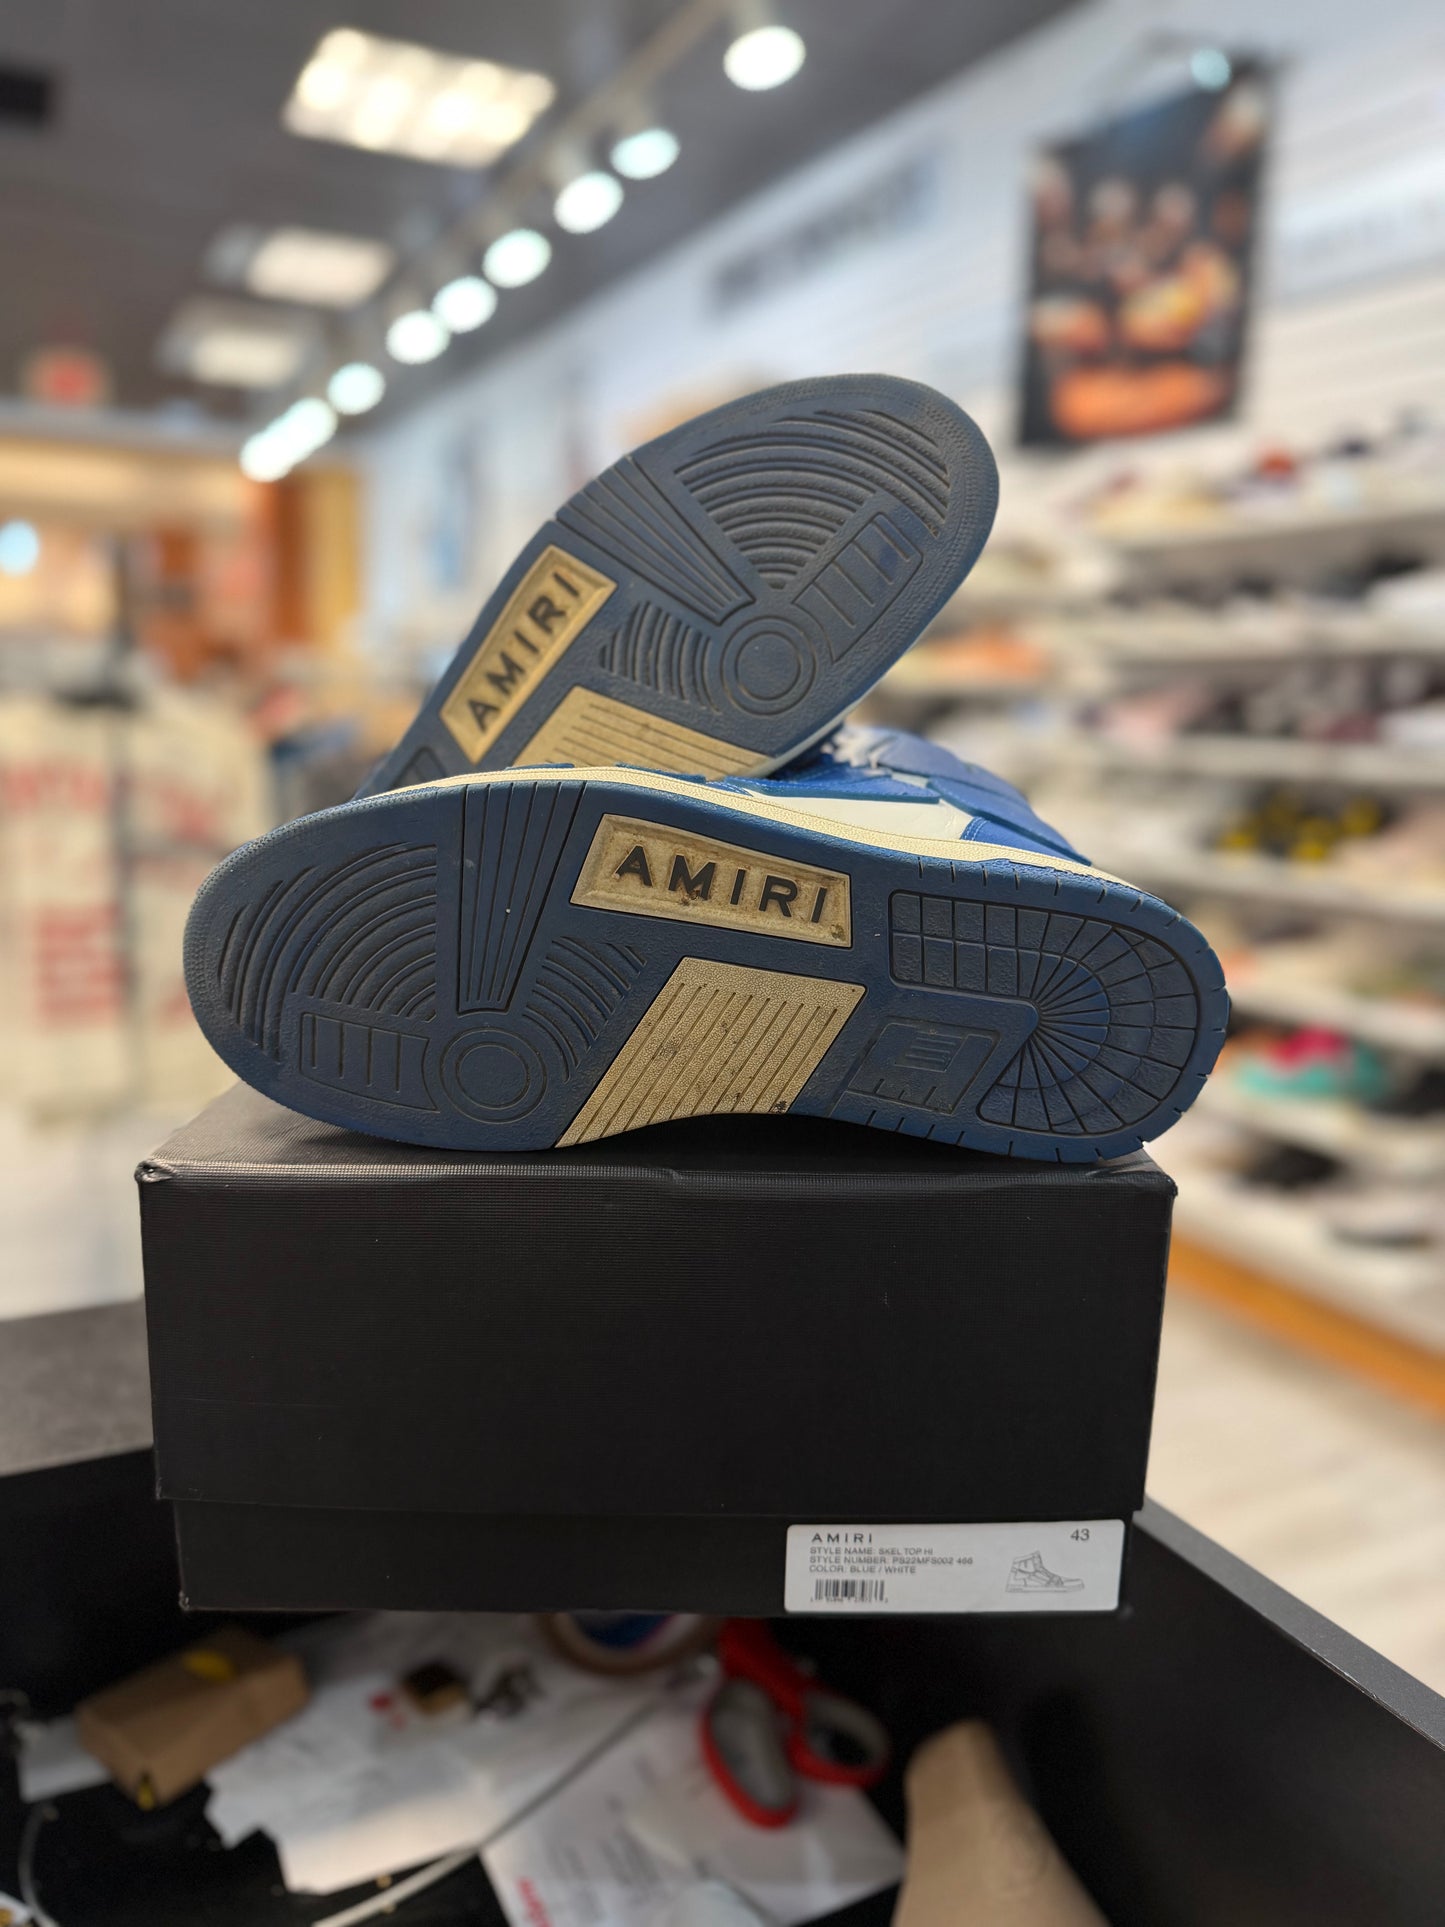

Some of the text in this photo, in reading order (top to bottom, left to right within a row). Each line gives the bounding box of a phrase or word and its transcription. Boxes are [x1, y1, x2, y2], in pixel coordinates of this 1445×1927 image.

[468, 571, 580, 733] AMIRI
[614, 845, 828, 923] AMIRI
[811, 1532, 872, 1543] AMIRI
[1070, 1528, 1090, 1541] 43
[810, 1547, 841, 1555] STYLE
[879, 1547, 901, 1556] SKEL
[904, 1547, 922, 1556] TOP
[923, 1547, 933, 1556] HI
[809, 1555, 841, 1564] STYLE
[850, 1565, 875, 1574] BLUE
[884, 1565, 916, 1575] WHITE
